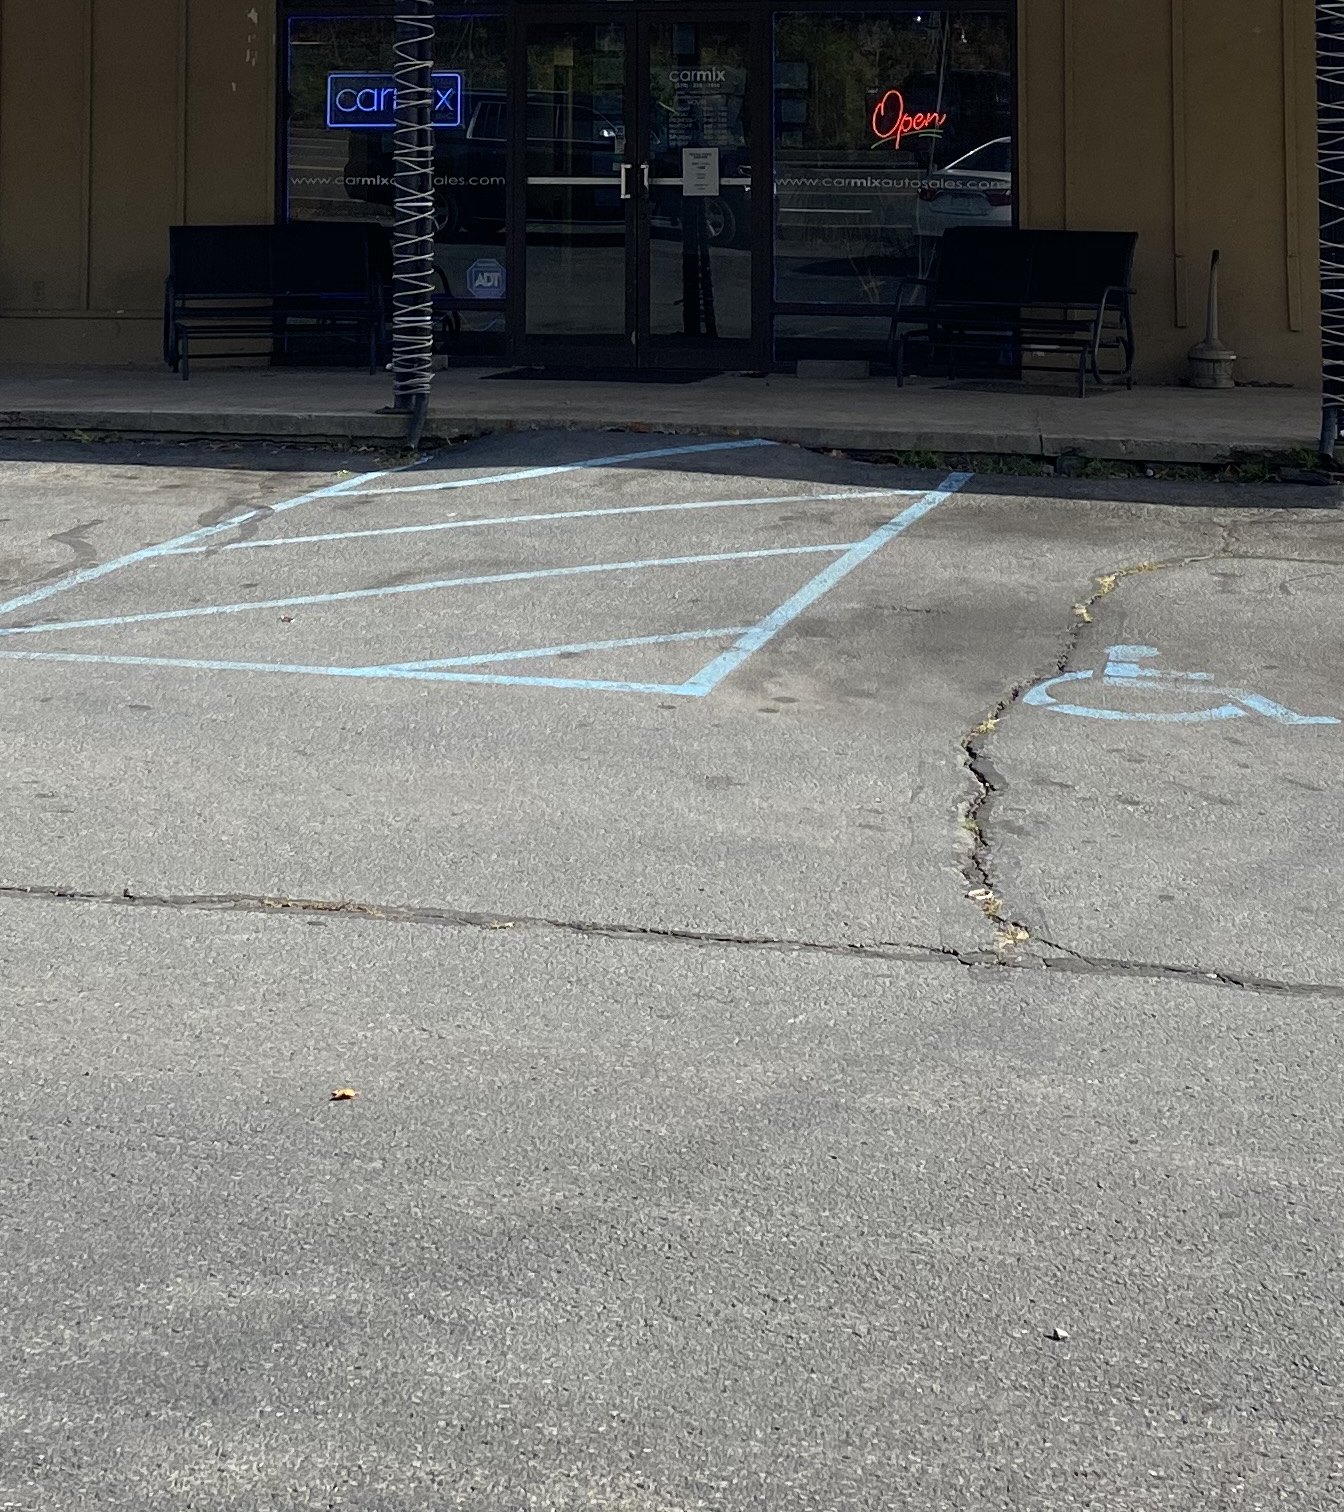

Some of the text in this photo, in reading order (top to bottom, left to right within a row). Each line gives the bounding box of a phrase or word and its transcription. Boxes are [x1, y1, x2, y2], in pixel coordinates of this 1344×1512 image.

[669, 66, 726, 82] carmix
[336, 87, 454, 112] carx
[872, 89, 947, 150] Open
[775, 176, 1008, 190] www.carmixautosales.com
[475, 272, 501, 287] ADT
